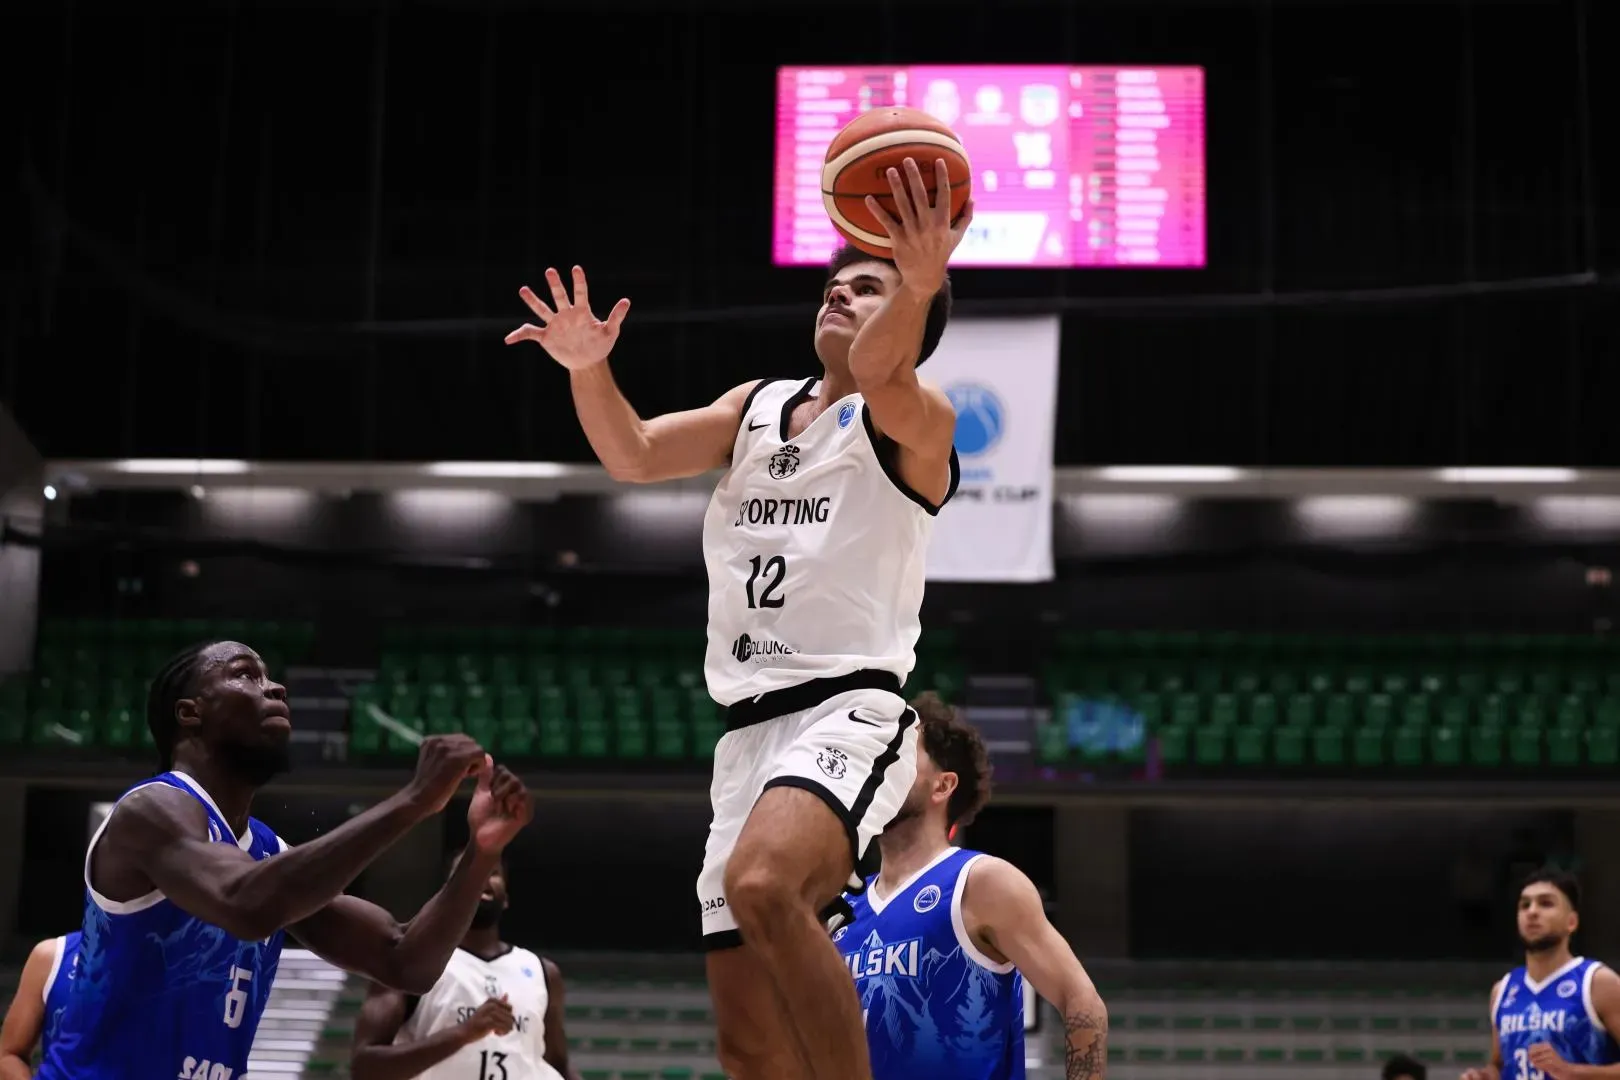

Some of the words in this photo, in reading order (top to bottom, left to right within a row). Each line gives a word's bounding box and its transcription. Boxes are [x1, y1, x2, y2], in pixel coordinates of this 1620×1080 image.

[734, 497, 831, 527] SPORTING
[745, 554, 787, 609] 12
[1500, 1008, 1566, 1037] RILSKI
[479, 1050, 508, 1080] 13
